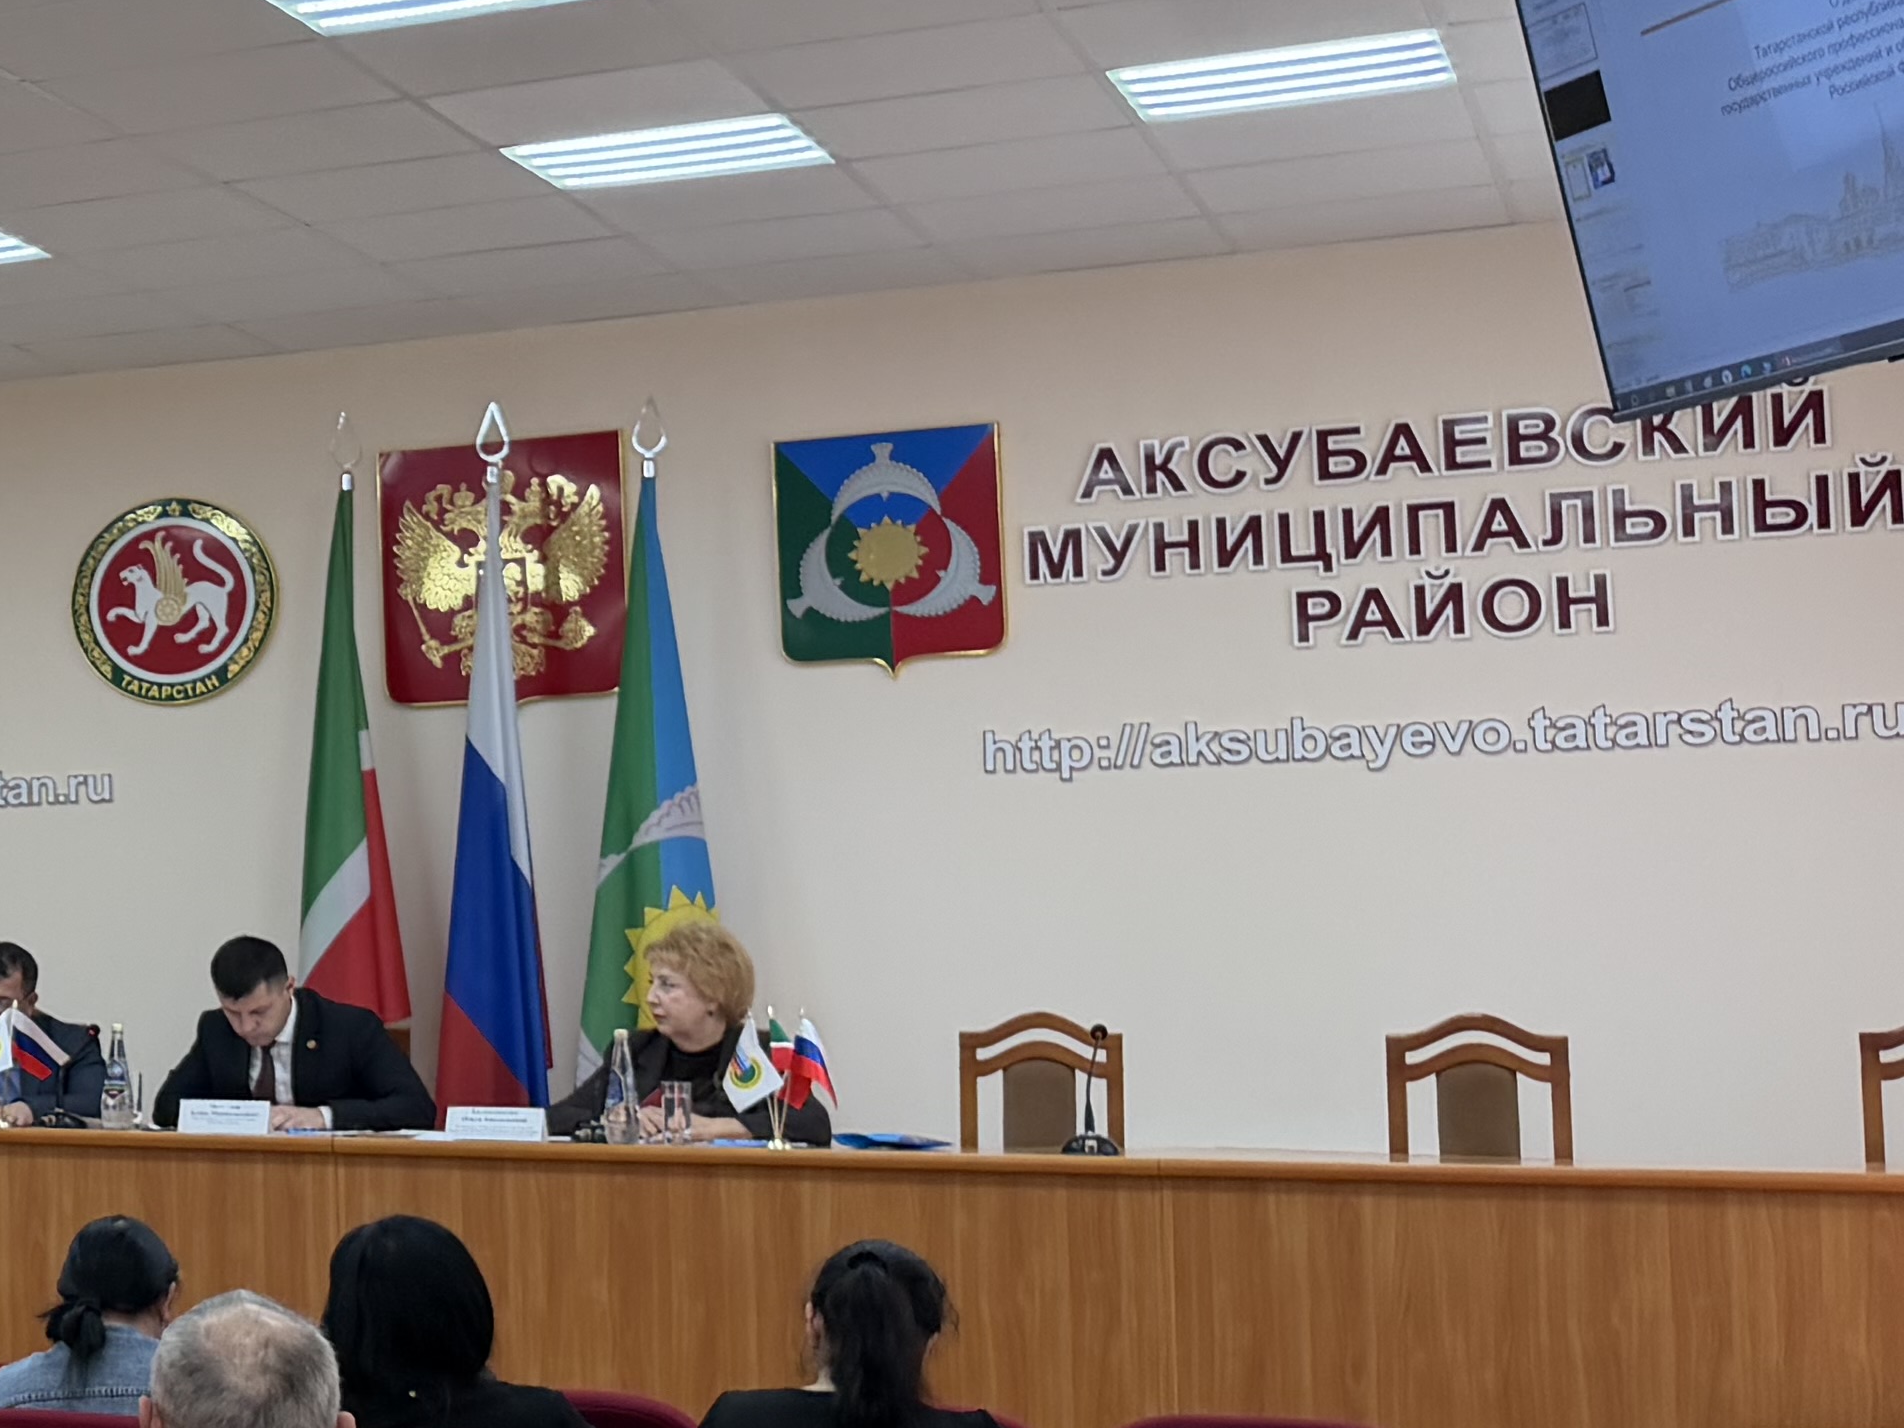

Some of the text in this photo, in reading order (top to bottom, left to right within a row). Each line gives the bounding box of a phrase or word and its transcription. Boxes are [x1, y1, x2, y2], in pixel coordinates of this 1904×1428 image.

[1077, 376, 1832, 503] АКСУБАЕВСКИЙ
[1023, 453, 1904, 586] МУНИЦИПАЛЬНЫЙ
[1292, 568, 1613, 647] РАЙОН
[120, 674, 220, 699] ТАТАРСТАН
[982, 697, 1904, 782] http://aksubayevo.tatarstan.ru
